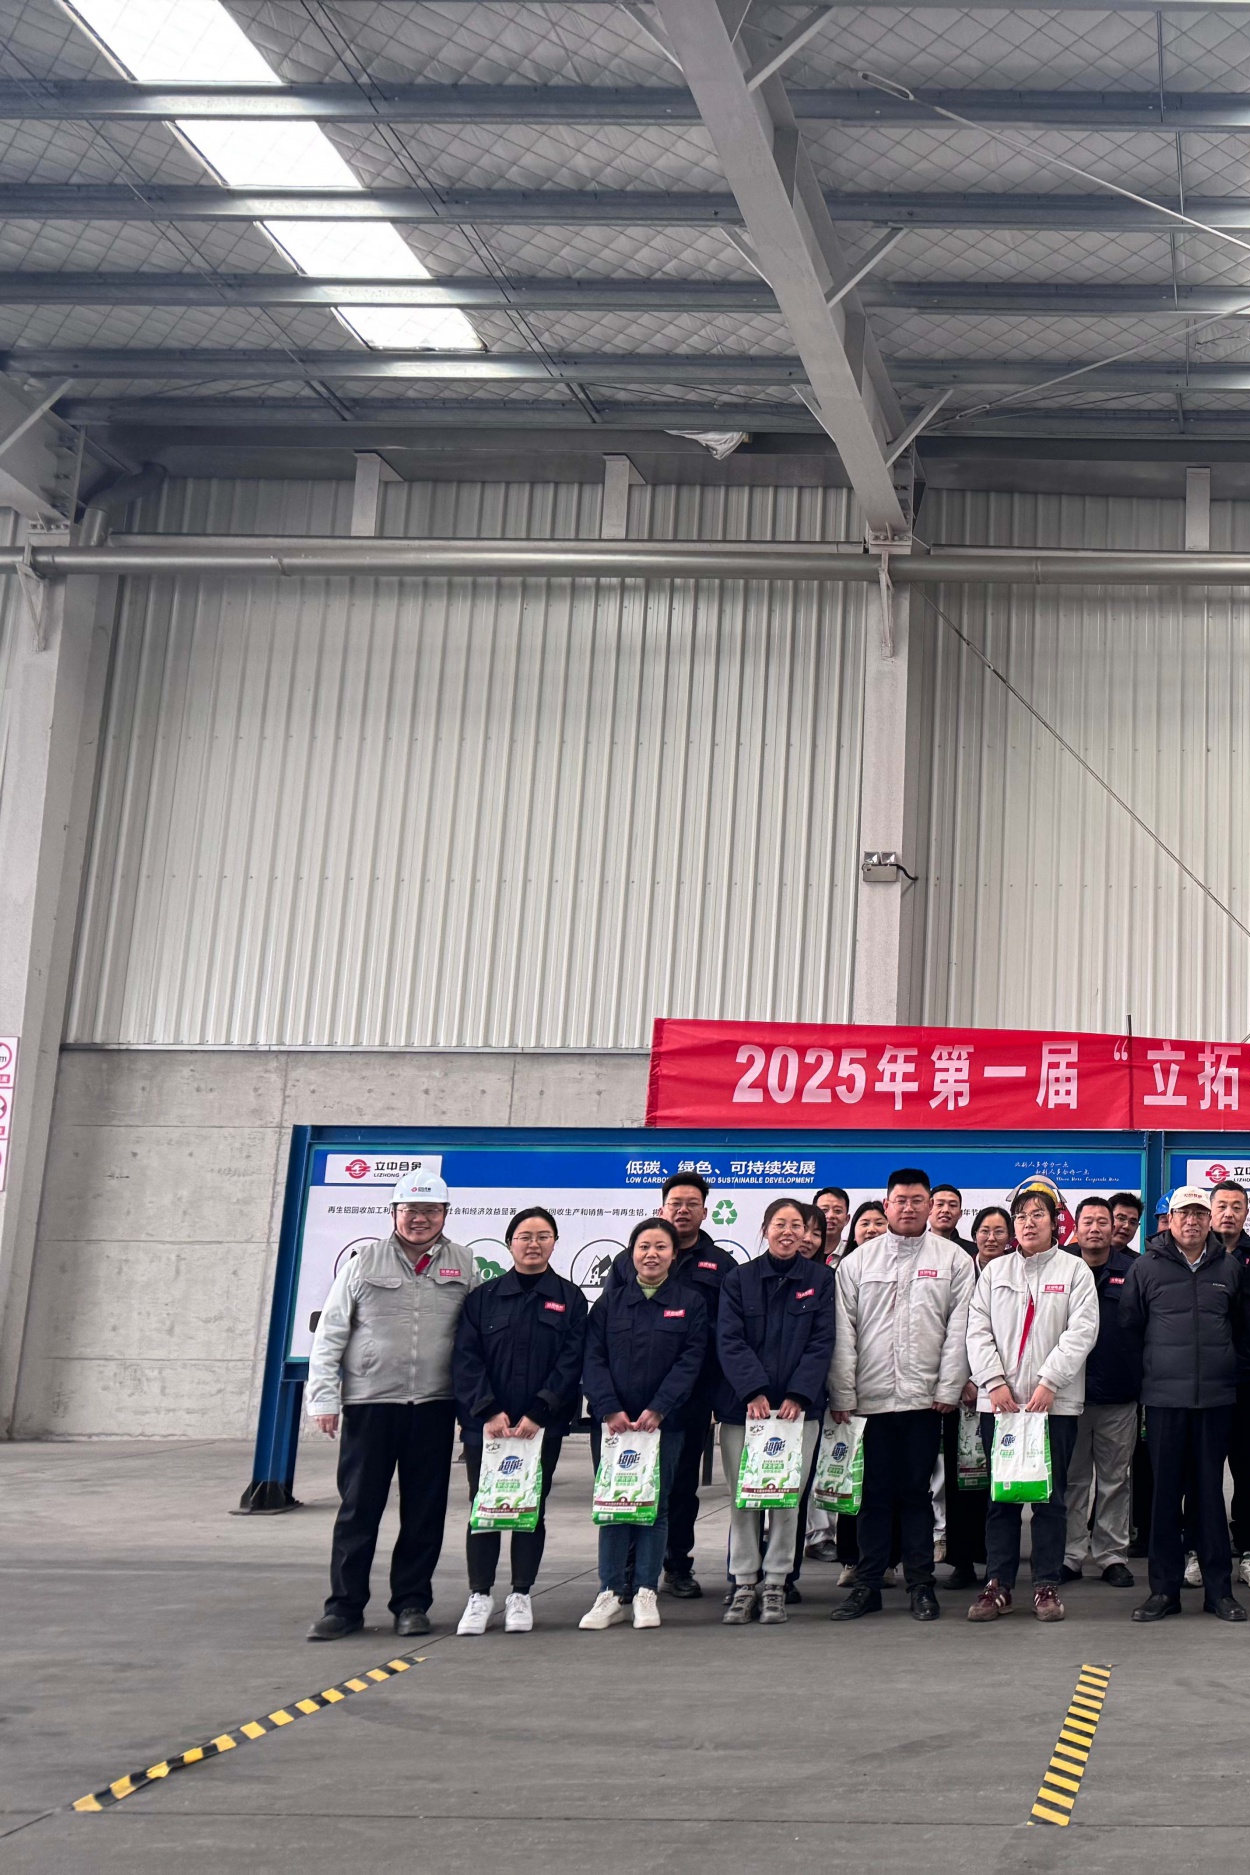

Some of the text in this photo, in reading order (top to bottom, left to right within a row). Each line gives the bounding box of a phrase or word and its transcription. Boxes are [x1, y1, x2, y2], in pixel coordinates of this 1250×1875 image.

[374, 1161, 422, 1171] 立中合金
[626, 1160, 816, 1175] 低碳、绿色、可持续发展
[642, 1176, 671, 1184] CARBO
[717, 1176, 763, 1184] SUSTAINABLE
[764, 1176, 815, 1184] DEVELOPMENT
